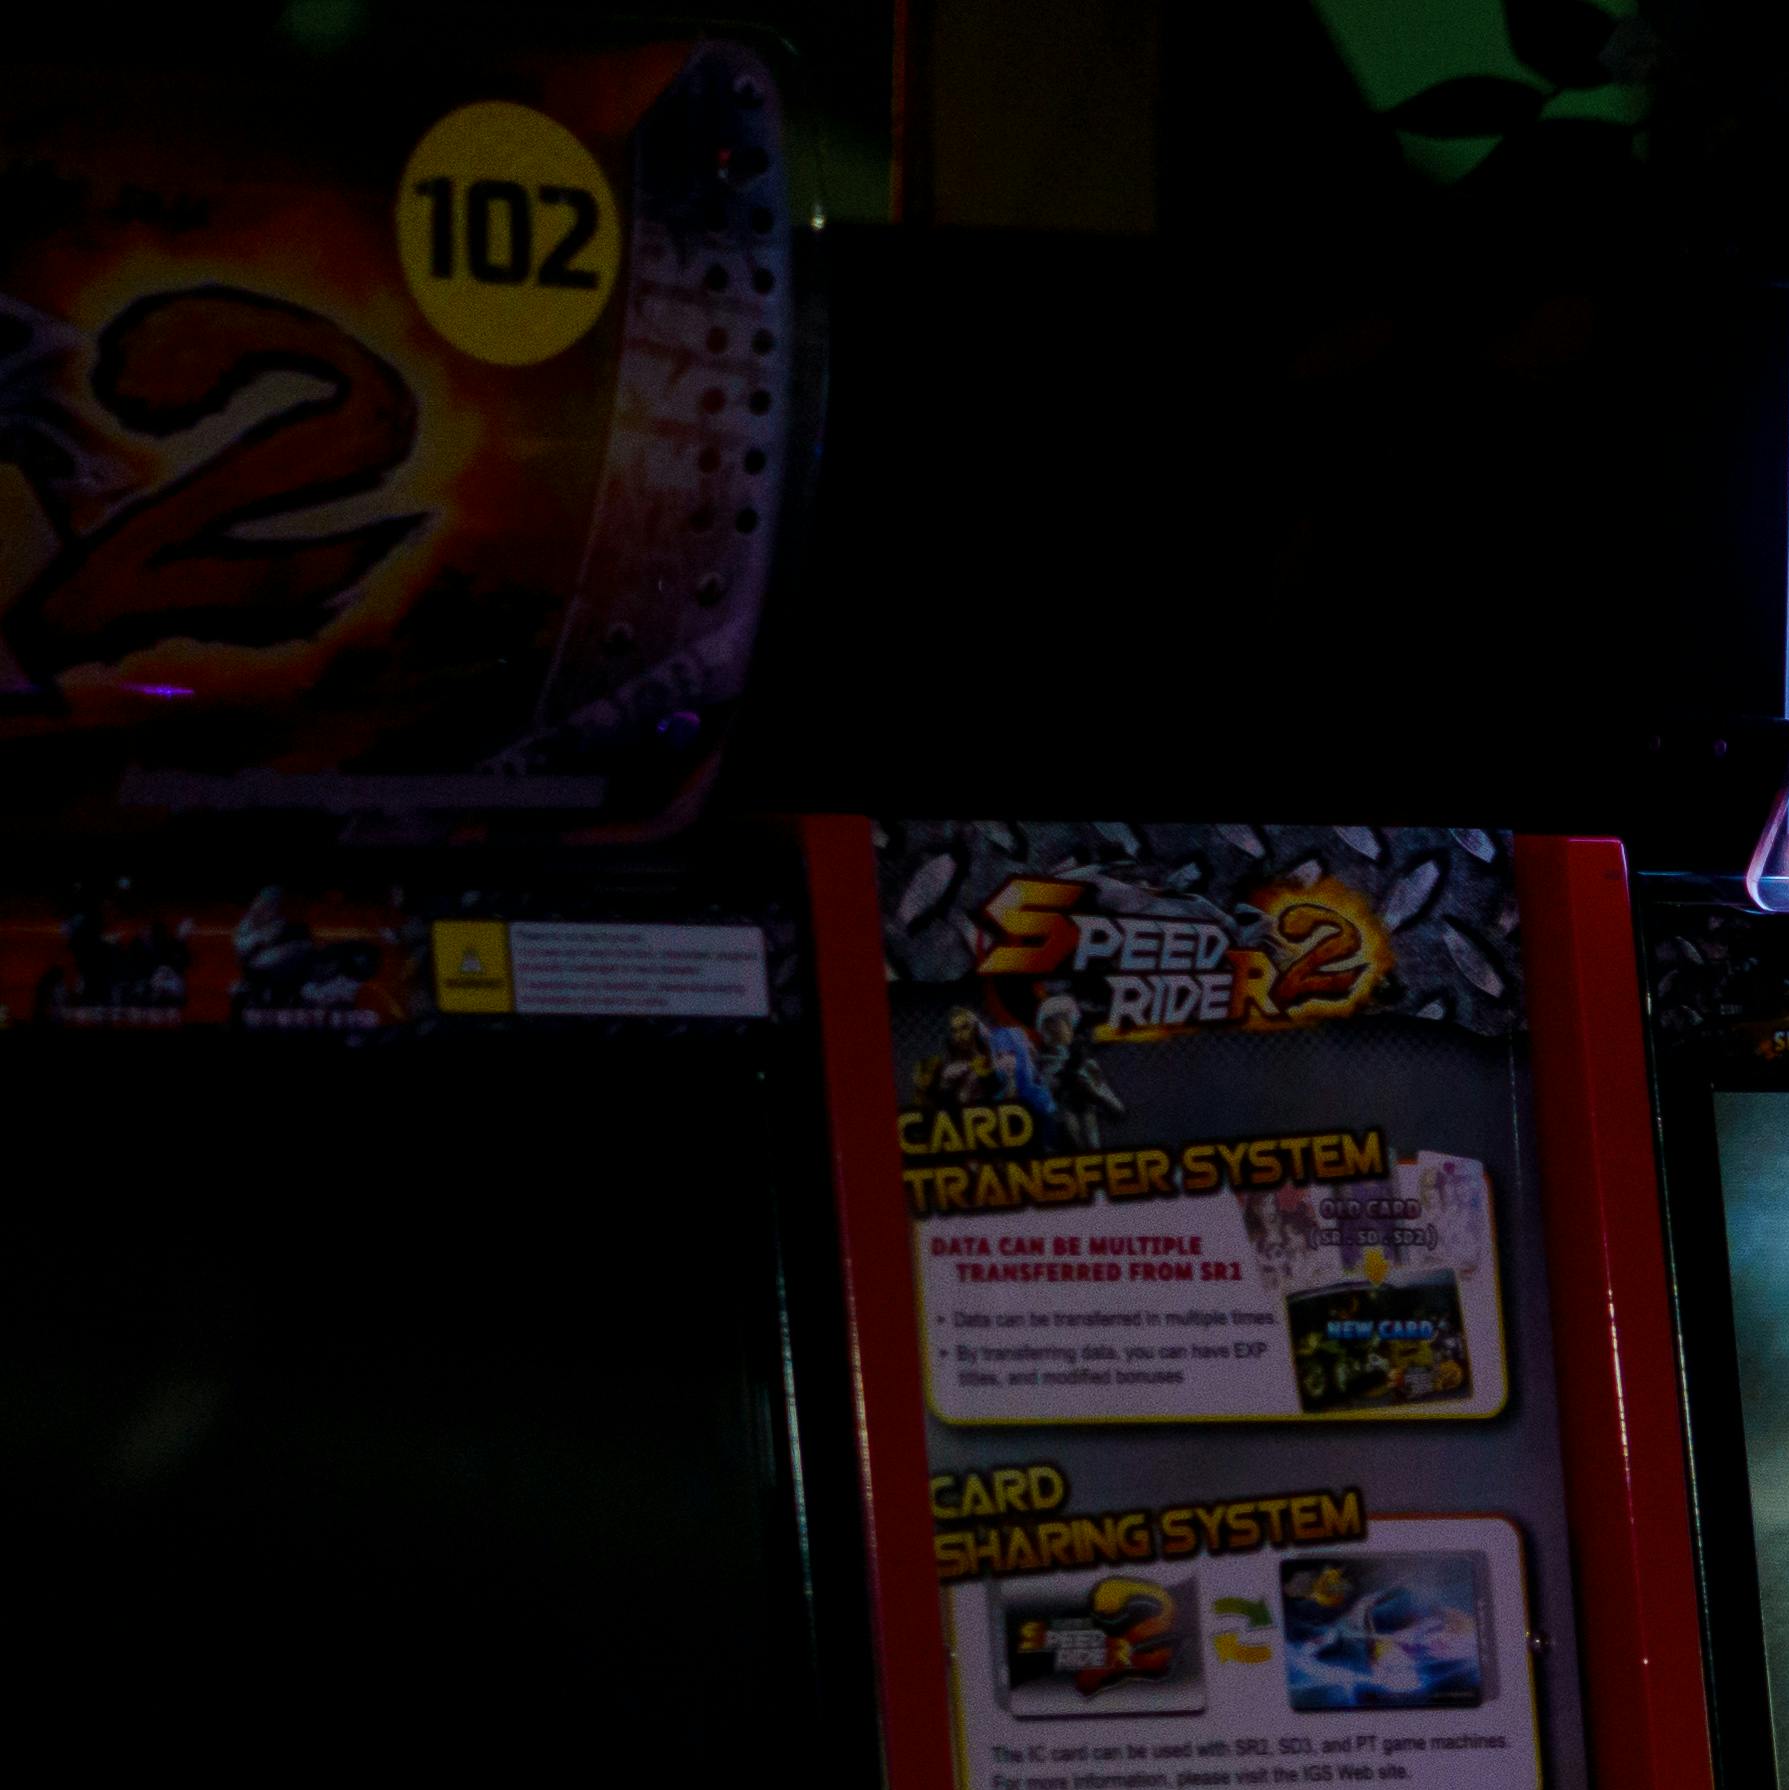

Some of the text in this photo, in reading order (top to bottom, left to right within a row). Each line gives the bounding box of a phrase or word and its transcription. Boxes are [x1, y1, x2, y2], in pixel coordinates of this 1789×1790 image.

[414, 176, 599, 288] 102
[52, 283, 438, 648] 2
[976, 877, 1230, 973] SPEED
[1277, 902, 1369, 1000] 2
[1104, 949, 1281, 1029] RIDER
[898, 1104, 1035, 1156] CARD
[902, 1129, 1386, 1214] TRANSFER SYSTEM
[931, 1236, 1202, 1256] DATA CAN BE MULTIPLE
[956, 1261, 1243, 1282] TRANSFERRED FROM SR1
[1053, 1311, 1145, 1328] transferred
[1166, 1310, 1229, 1330] multiple
[981, 1343, 1077, 1364] transferring
[1191, 1342, 1230, 1360] have
[1234, 1342, 1269, 1360] EXP
[929, 1464, 1066, 1519] CARD
[933, 1490, 1365, 1578] SHARING SYSTEM
[1153, 1741, 1193, 1760] used
[1321, 1736, 1352, 1755] and
[1382, 1738, 1427, 1756] game
[1176, 1768, 1232, 1790] please
[1337, 1763, 1374, 1781] Web
